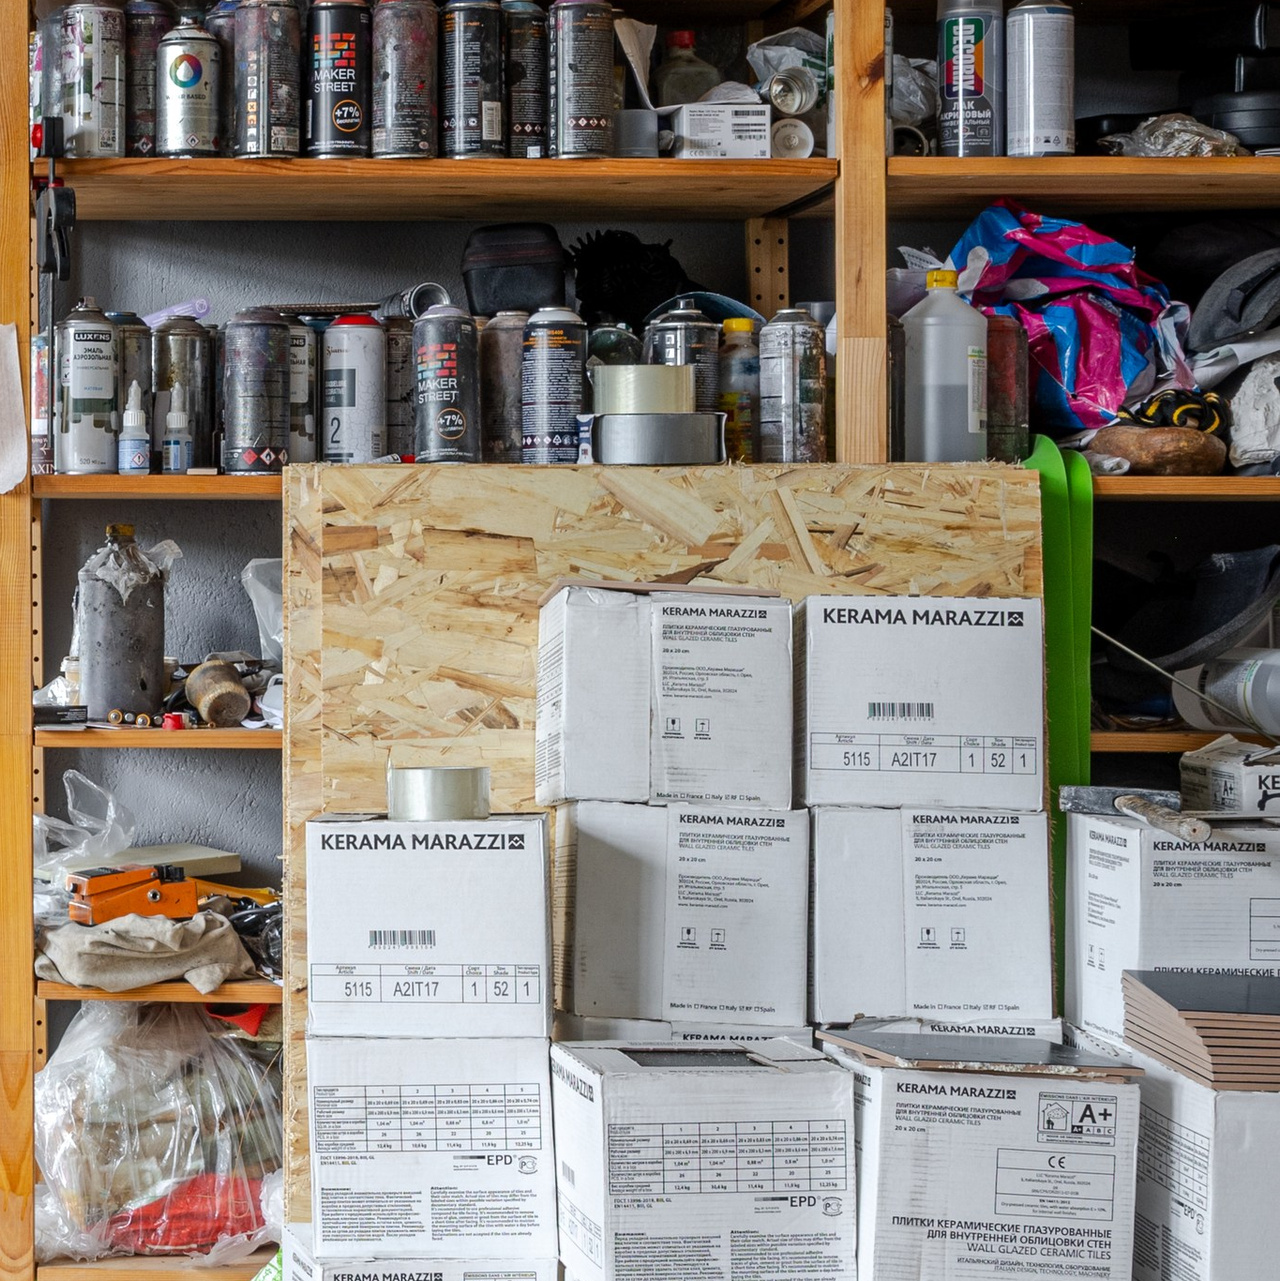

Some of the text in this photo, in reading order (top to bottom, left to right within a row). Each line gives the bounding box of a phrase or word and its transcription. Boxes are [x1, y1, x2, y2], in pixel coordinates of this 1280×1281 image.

[952, 24, 975, 92] DECORIX
[314, 69, 355, 81] MAKER
[314, 82, 355, 93] STREET
[335, 106, 360, 119] +7%
[75, 333, 110, 341] LUXENS
[418, 378, 457, 391] MAKER
[418, 391, 457, 404] STREET
[438, 414, 463, 425] +7%
[330, 417, 341, 444] 2
[662, 607, 757, 618] KERAMA MARAZZI
[823, 608, 1005, 626] KERAMA MARAZZI
[843, 752, 1026, 768] 5115 A2IT17 1 52 1
[679, 814, 775, 827] KERAMA MARAZZI
[913, 815, 1009, 825] KERAMA MARAZZI
[321, 834, 505, 850] KERAMA MARAZZI
[1153, 842, 1255, 852] KERAMA MARAZZI
[344, 981, 530, 996] 5115 A2IT17 1 52 1
[930, 1024, 1026, 1036] KERAMA MARAZZI
[896, 1083, 1006, 1099] KERAMA MARAZZI
[1079, 1104, 1112, 1124] A+
[487, 1154, 512, 1165] EPD
[790, 1196, 816, 1207] EPD
[892, 1216, 1112, 1238] ПЛИТКИ КЕРАМИЧЕСКИЕ ГЛАЗУРОВАННЫЕ
[927, 1229, 1111, 1249] ДЛЯ ВНУТРЕННЕЙ ОБЛИЦОВКИ СТЕН
[967, 1243, 1111, 1260] WALL GLAZED CERAMIC TILES
